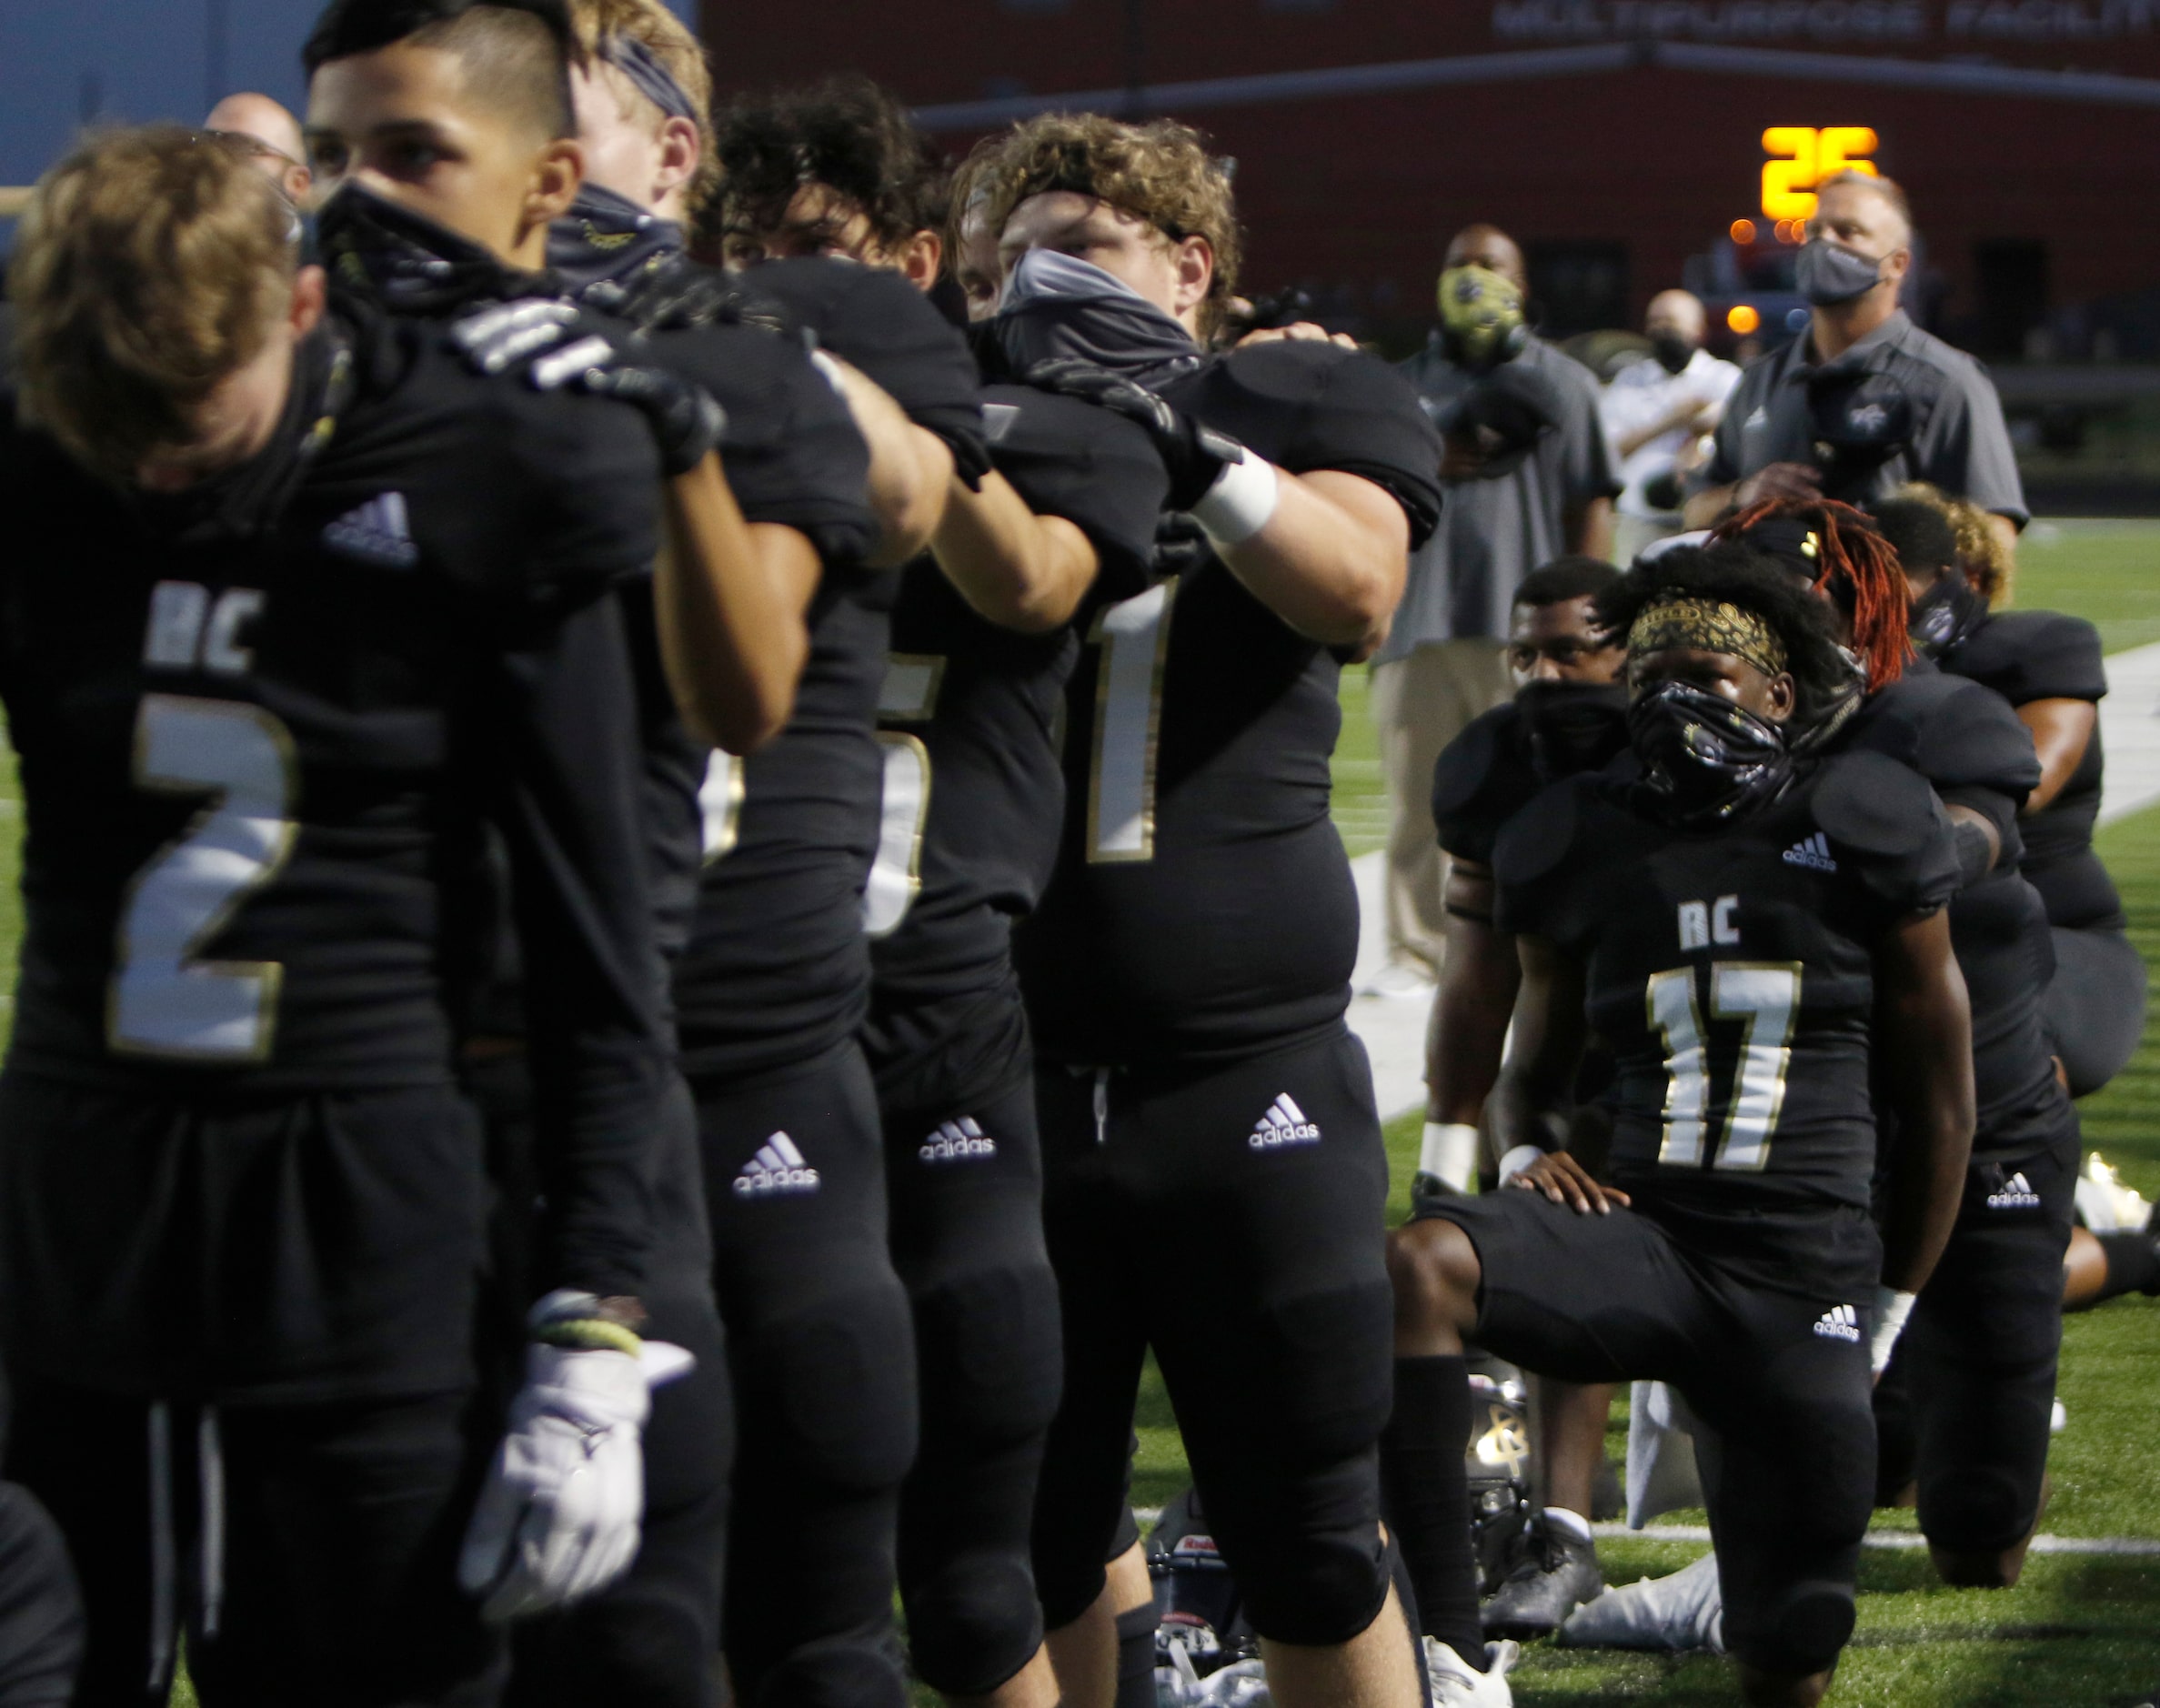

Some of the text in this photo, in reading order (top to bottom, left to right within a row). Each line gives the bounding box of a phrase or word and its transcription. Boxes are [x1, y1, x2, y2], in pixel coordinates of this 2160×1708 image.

[1782, 849, 1837, 873] adidas
[107, 691, 301, 1062] 2
[1677, 893, 1742, 952] RC
[1644, 959, 1803, 1172] 17
[918, 1134, 997, 1161] adidas
[1248, 1121, 1321, 1150] adidas
[732, 1165, 819, 1194] adidas
[1986, 1191, 2040, 1210] adidas
[1813, 1319, 1860, 1343] adidas
